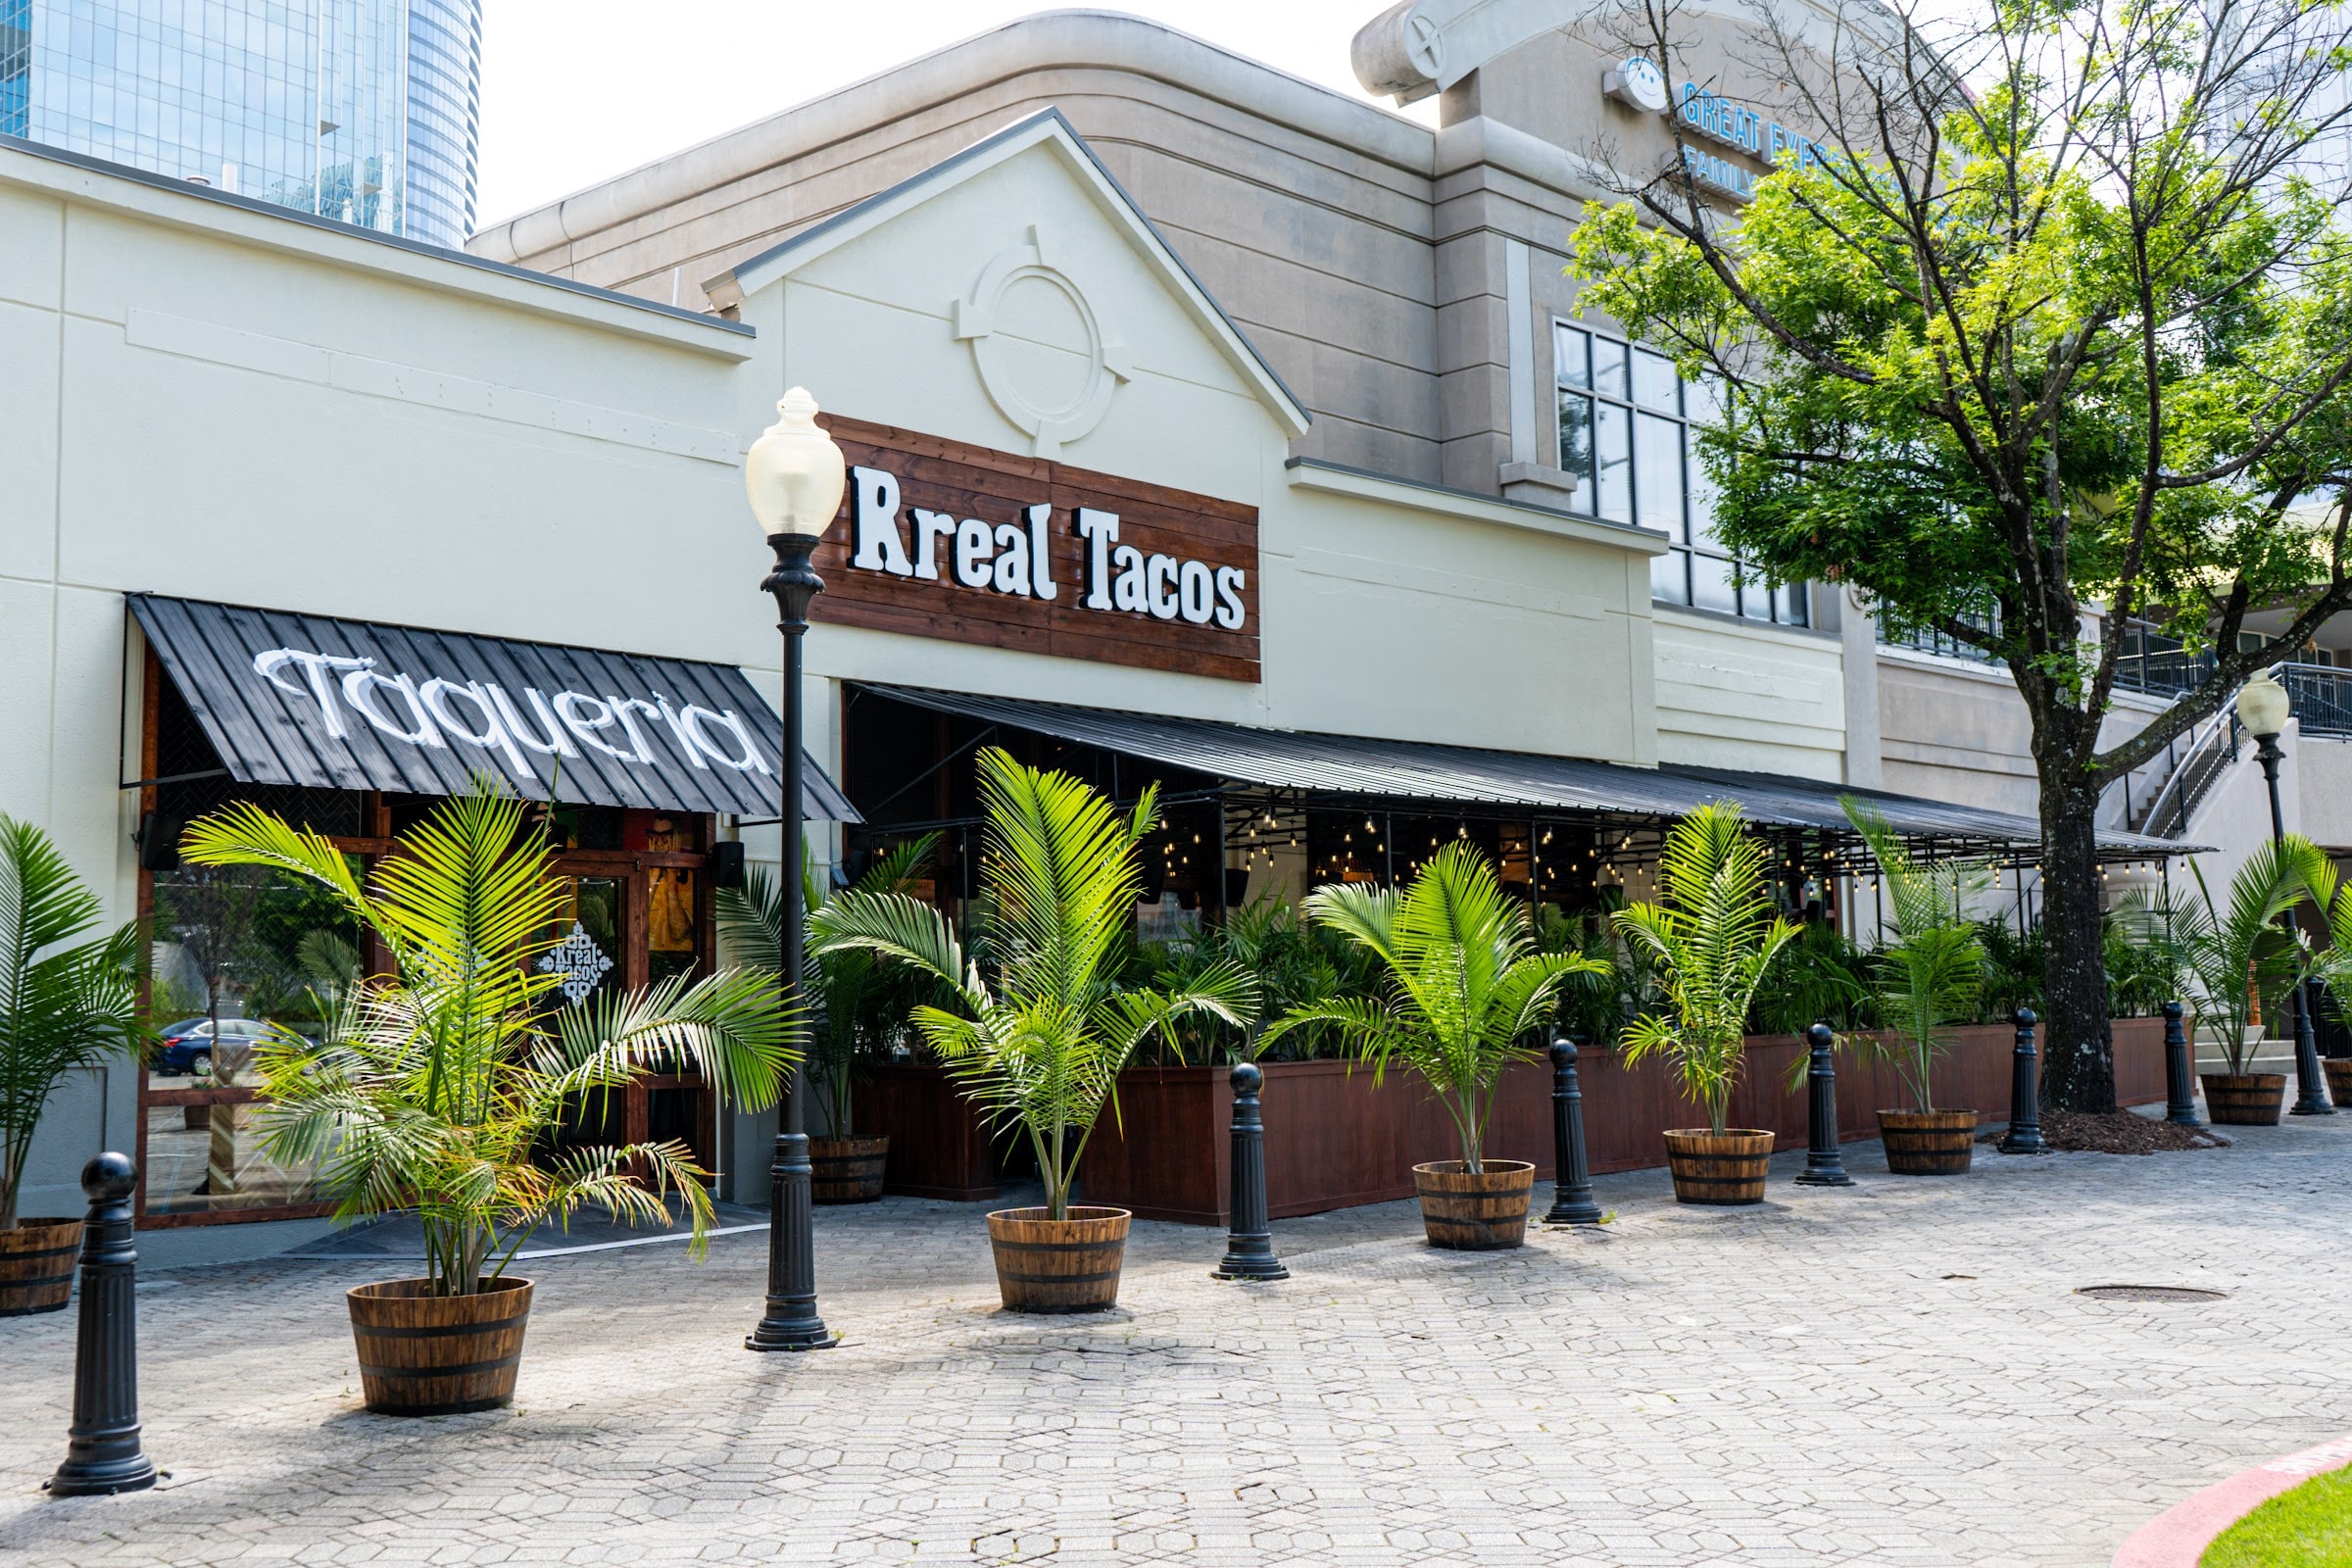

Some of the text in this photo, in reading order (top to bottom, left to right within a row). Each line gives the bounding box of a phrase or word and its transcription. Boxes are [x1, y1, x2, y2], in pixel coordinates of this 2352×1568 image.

[1683, 80, 1761, 153] GREAT
[1684, 144, 1760, 198] FAMILY
[849, 465, 1247, 630] Rreal Tacos
[252, 646, 774, 779] Taqueria
